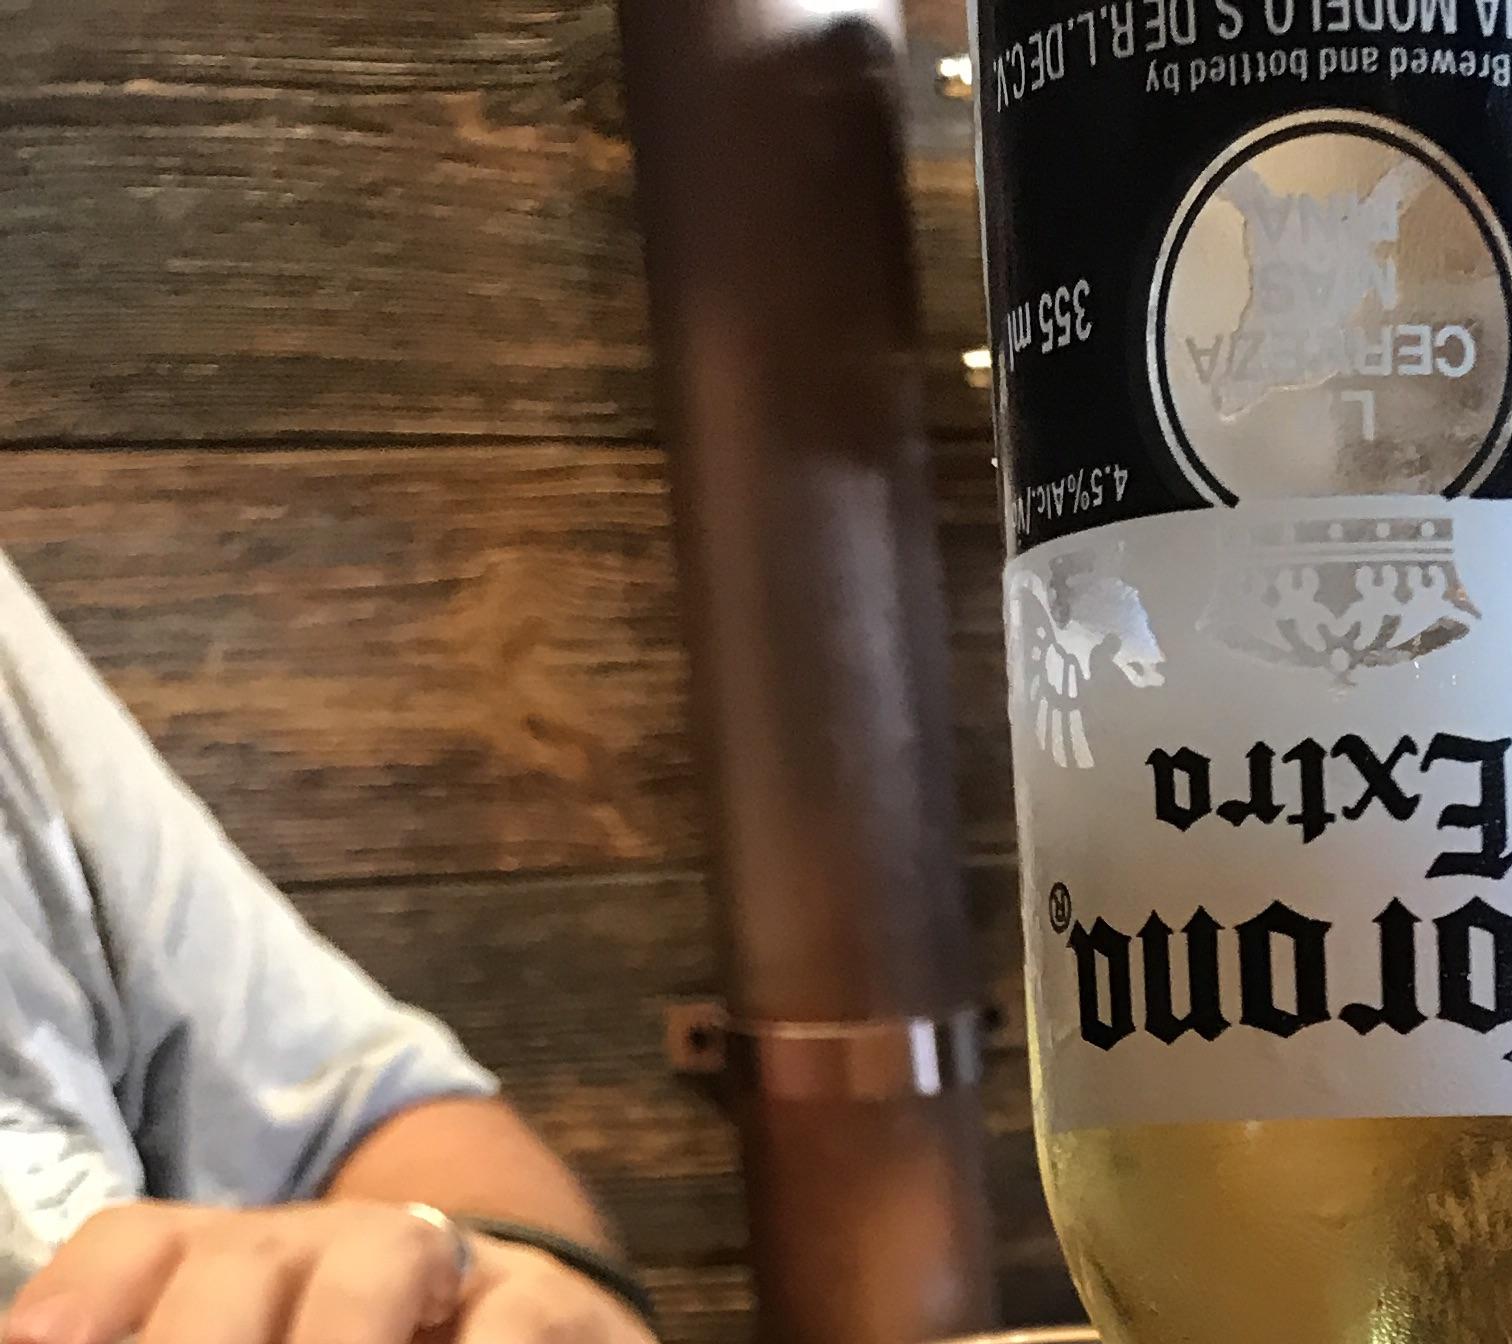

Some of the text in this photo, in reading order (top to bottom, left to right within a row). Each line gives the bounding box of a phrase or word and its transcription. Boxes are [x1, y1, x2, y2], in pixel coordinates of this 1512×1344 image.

[1145, 47, 1512, 96] Brewed and bottled by
[1038, 278, 1093, 354] 355
